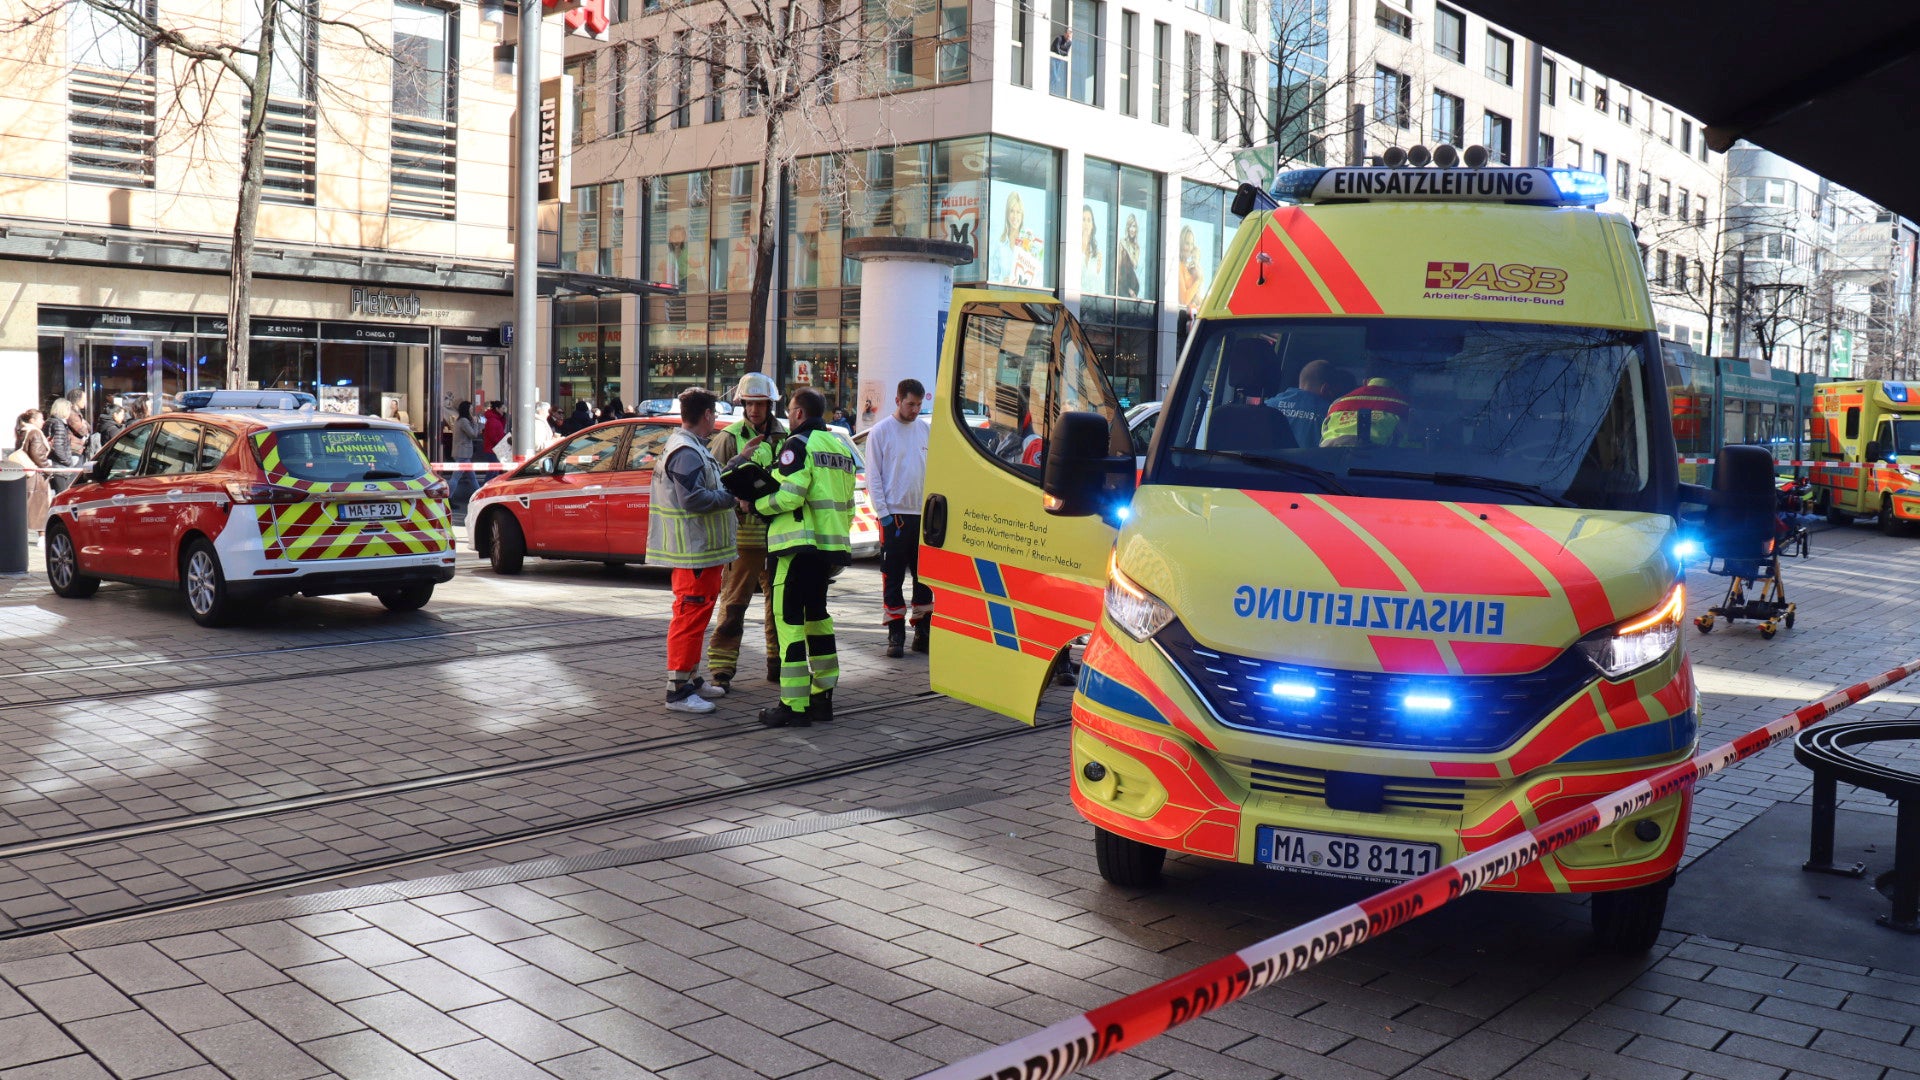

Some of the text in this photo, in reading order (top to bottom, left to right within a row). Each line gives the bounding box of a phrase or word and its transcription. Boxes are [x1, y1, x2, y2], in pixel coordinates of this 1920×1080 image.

[539, 97, 556, 184] Pletzsch
[1334, 171, 1534, 196] EINSATZLEITUNG
[941, 196, 979, 208] Müller
[1455, 263, 1568, 295] ASB
[351, 286, 421, 317] Pletzsch
[1423, 291, 1565, 306] Arbeiter-Samariter-Bund
[101, 313, 132, 325] Pletzsch
[267, 325, 304, 333] ZENITH
[1278, 400, 1296, 409] ELW
[321, 434, 382, 443] FEUERWEHR
[325, 444, 388, 454] MANNHEIM
[356, 454, 377, 463] 112
[349, 503, 398, 517] MA F 239
[963, 508, 1048, 534] Arbeiter-Samariter-Bund
[963, 521, 1031, 546] Baden-Württemberg
[962, 533, 985, 547] Region
[986, 540, 1024, 556] Mannheim
[1031, 549, 1082, 570] Rhein-Neckar
[1274, 834, 1432, 877] MA SB 8111
[1266, 864, 1286, 872] IVECO
